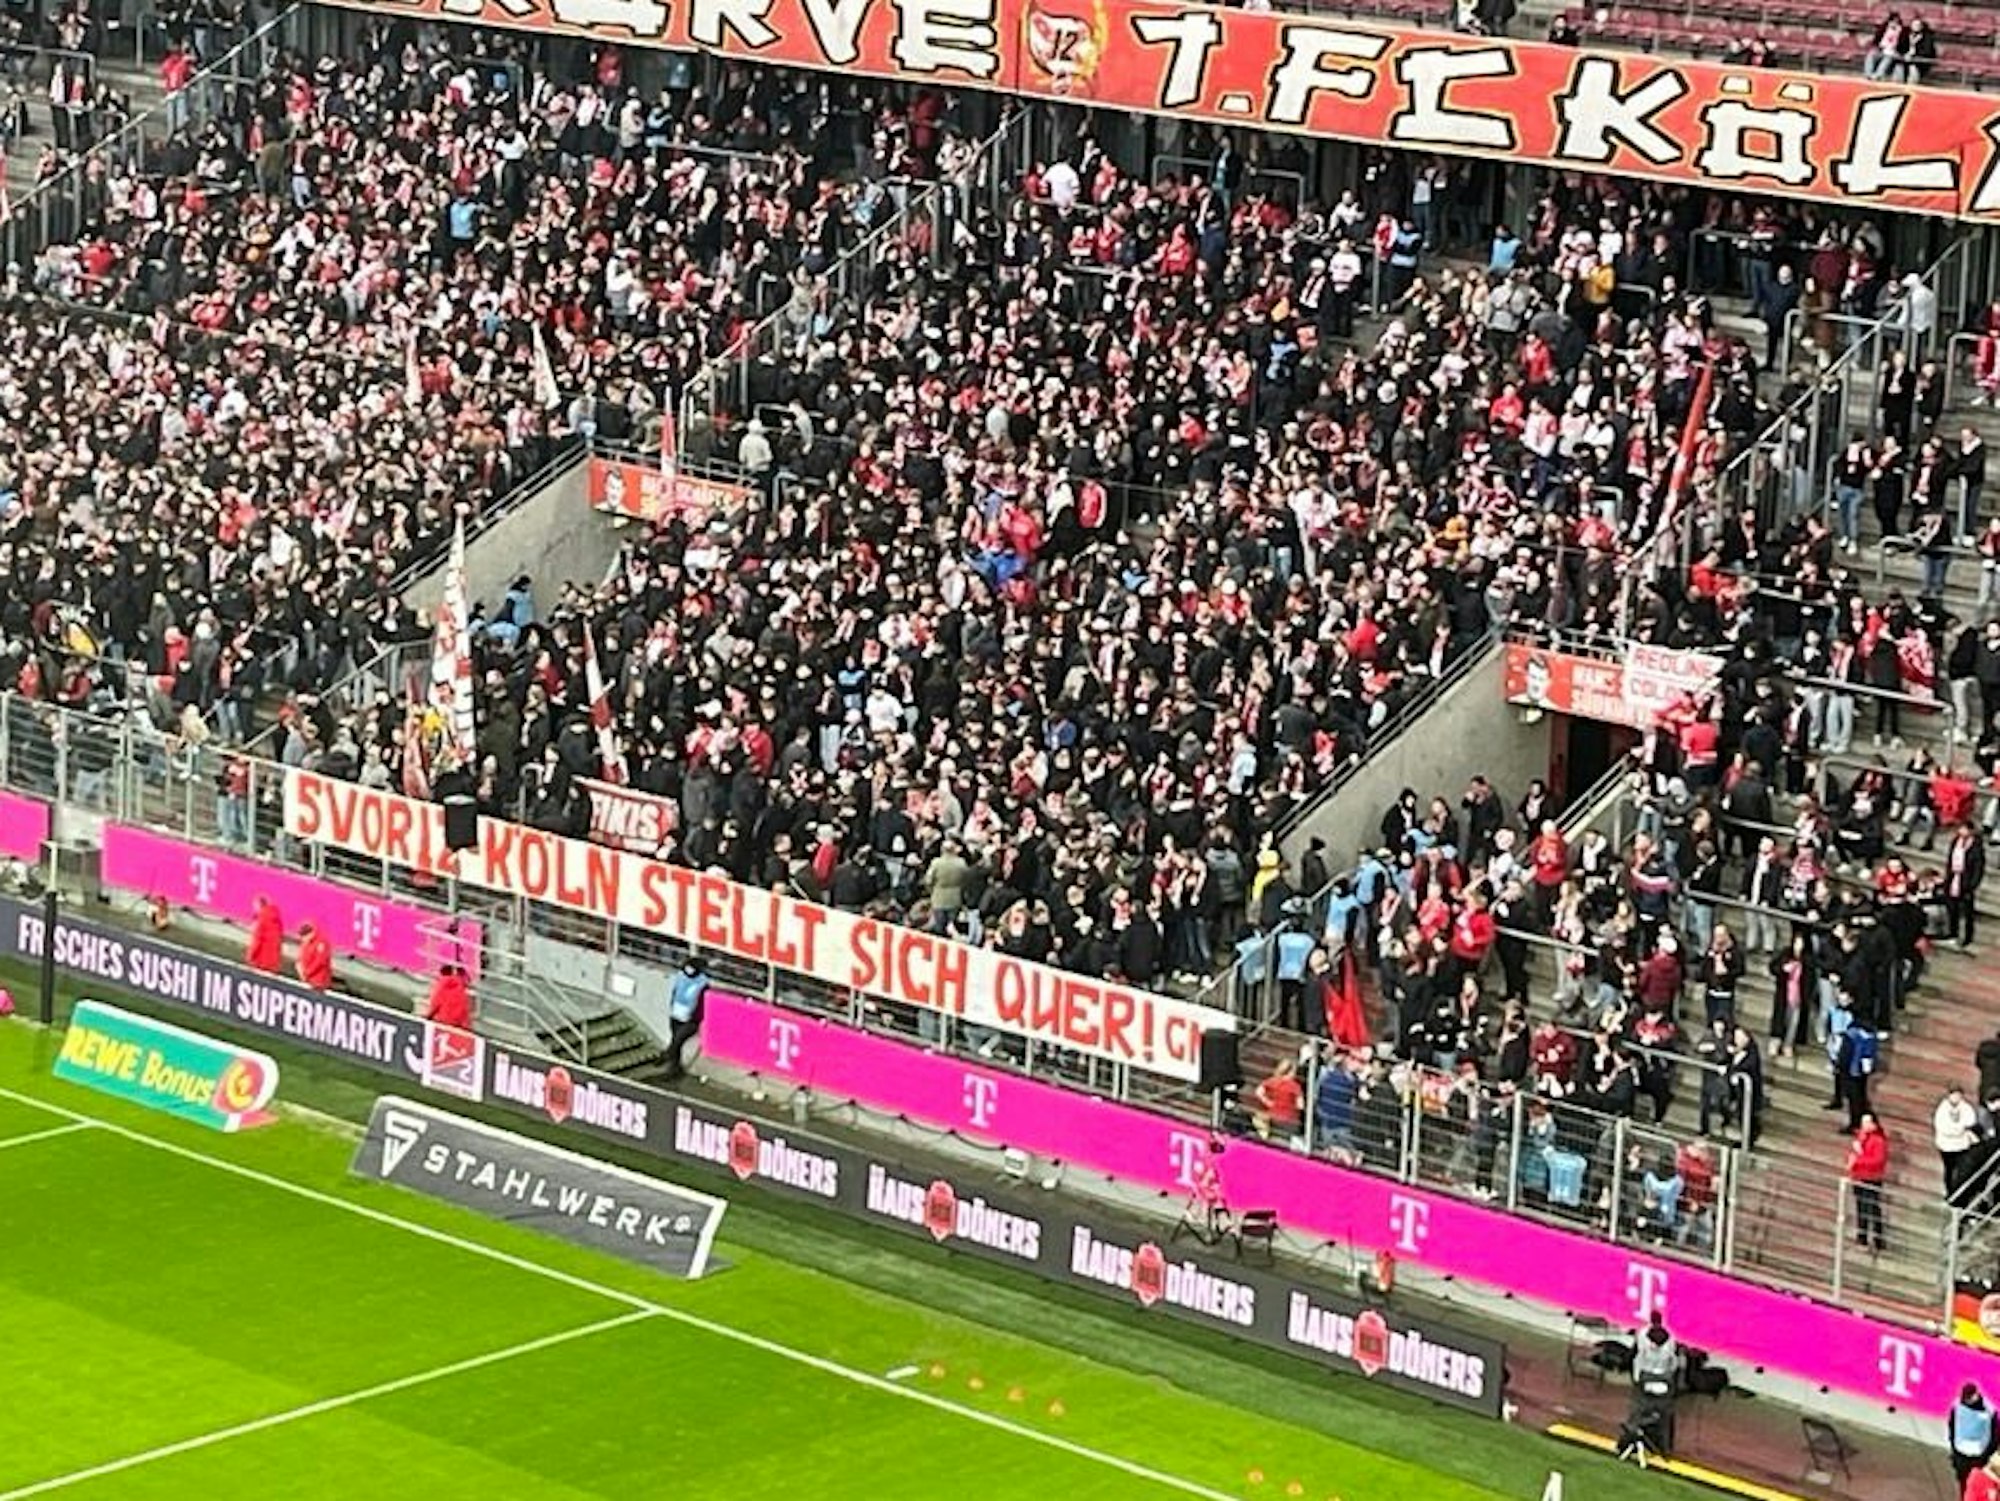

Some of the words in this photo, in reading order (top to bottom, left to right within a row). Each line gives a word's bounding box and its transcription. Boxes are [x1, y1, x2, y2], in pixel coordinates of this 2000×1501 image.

[1555, 57, 2000, 213] KÖL
[486, 821, 620, 917] KÖLN
[640, 864, 825, 971] STELLT
[850, 917, 968, 1014] SICH
[994, 961, 1154, 1063] QUER!
[18, 914, 124, 980] FRSCHES
[128, 948, 198, 1002] SUSHI
[202, 969, 232, 1014] IM
[237, 980, 398, 1063] SUPERMARKT
[60, 1025, 143, 1080] REWE
[140, 1050, 216, 1108] Bonus
[572, 1081, 647, 1140] DÖNERS
[757, 1132, 837, 1198] DÖNERS
[955, 1194, 1041, 1260] DÖNERS
[1164, 1260, 1255, 1327] DÖNERS
[1388, 1329, 1484, 1399] DÖNERS
